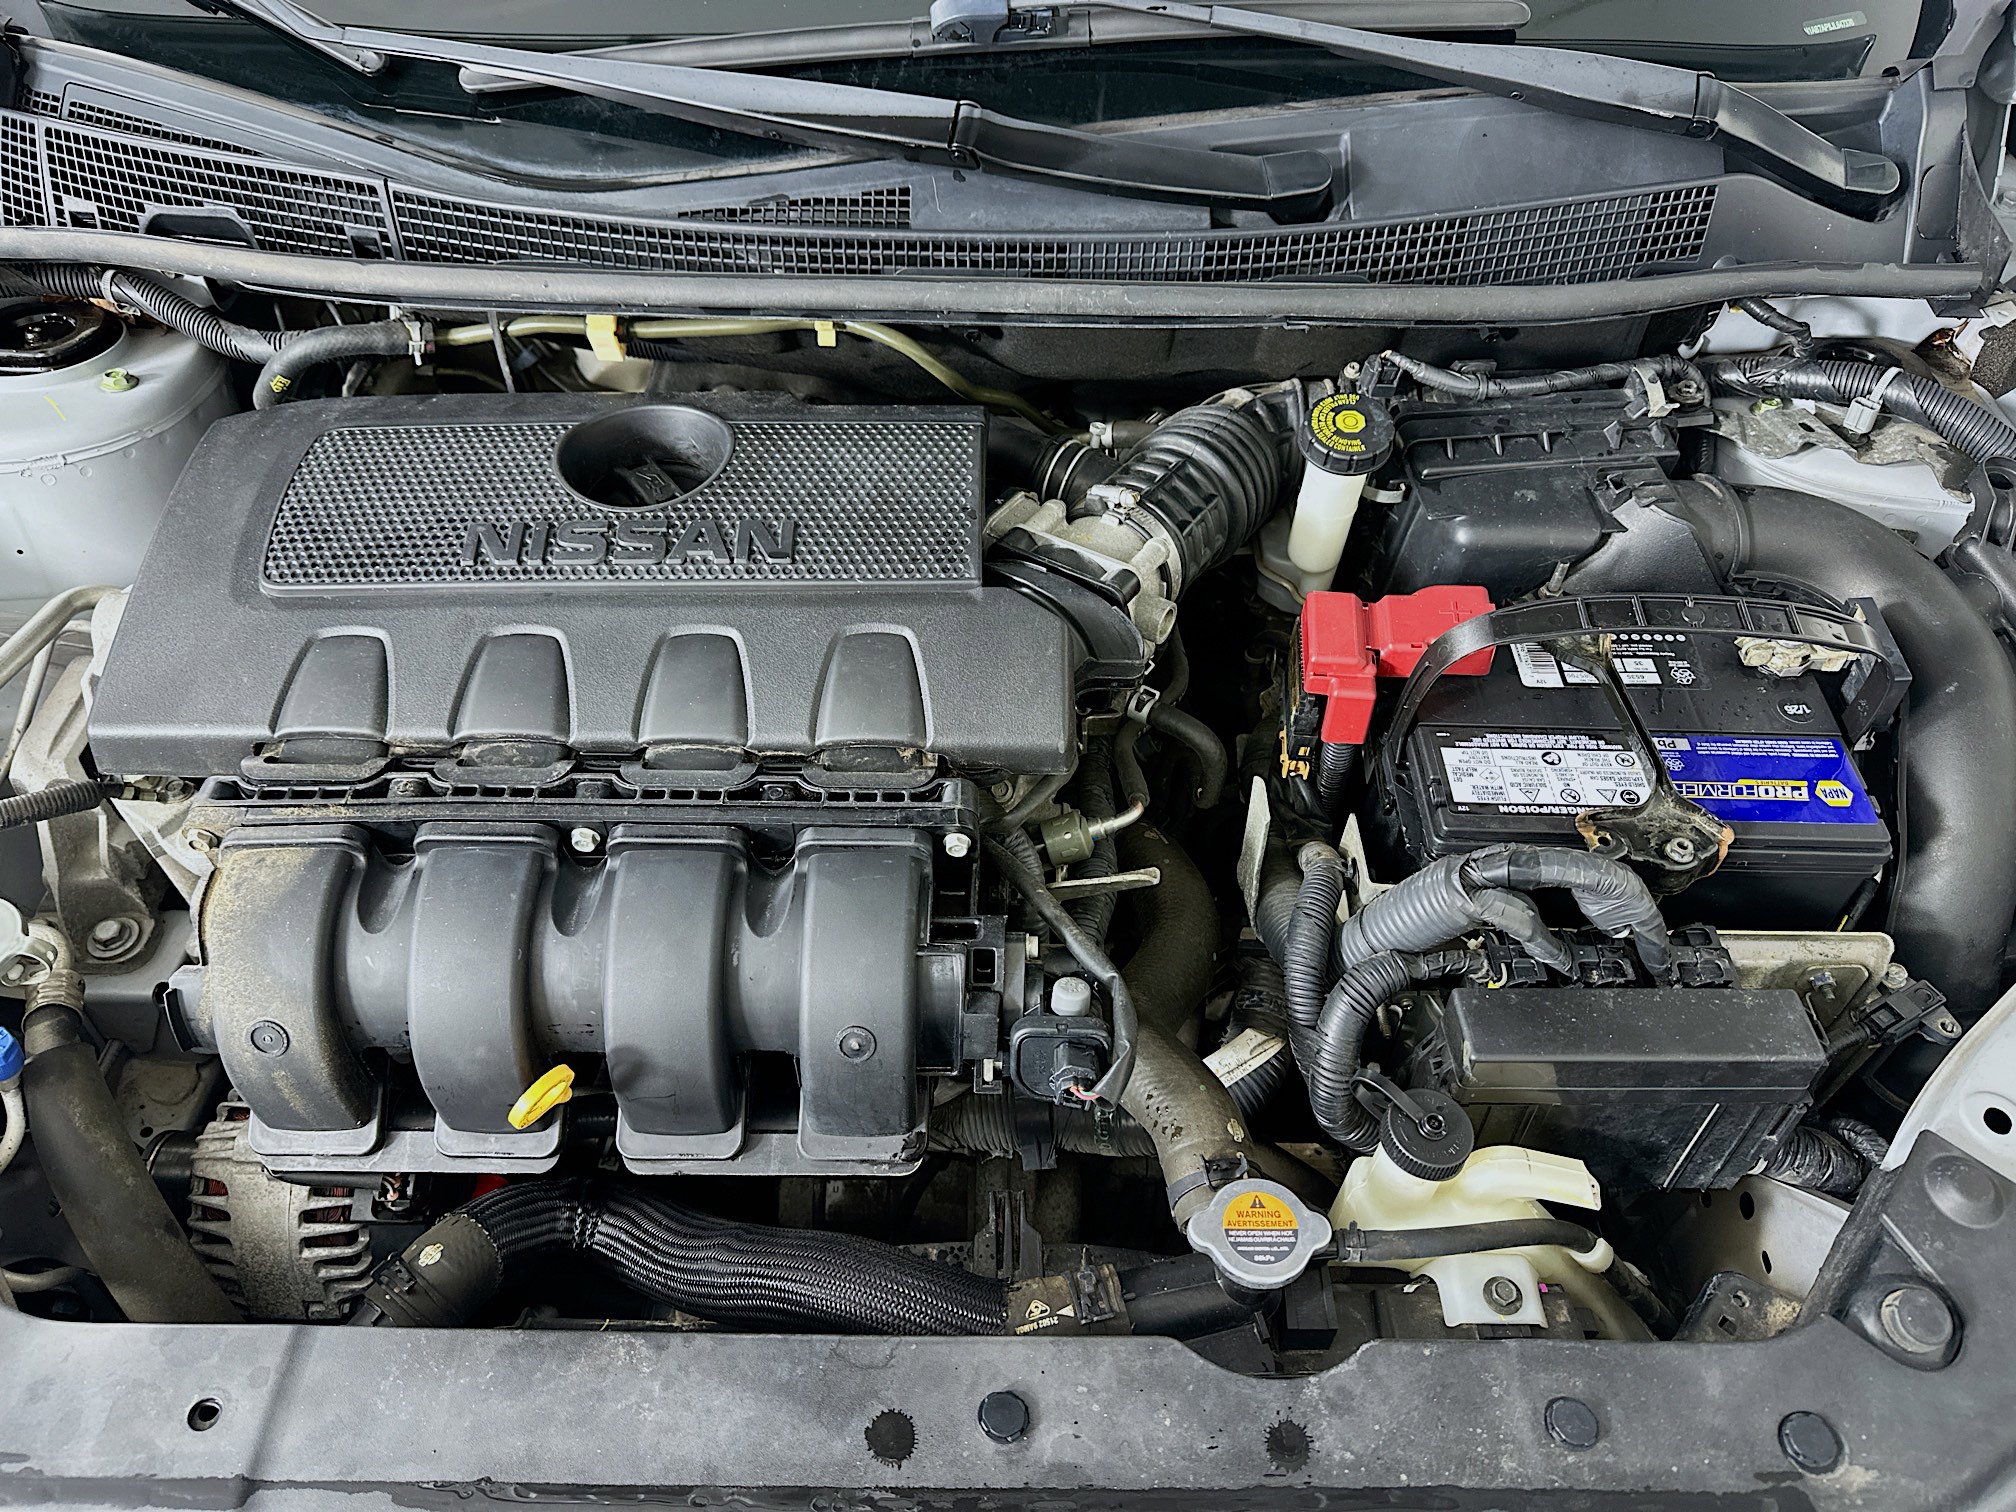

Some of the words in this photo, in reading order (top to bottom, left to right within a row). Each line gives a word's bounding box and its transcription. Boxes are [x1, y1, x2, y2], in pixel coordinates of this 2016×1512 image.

[460, 519, 799, 566] NISSAN
[1784, 704, 1812, 714] 1/26
[1658, 740, 1677, 748] Pb
[1820, 788, 1848, 799] NAPA
[1498, 805, 1600, 814] NGER/POISON
[1236, 1210, 1281, 1219] WARNING
